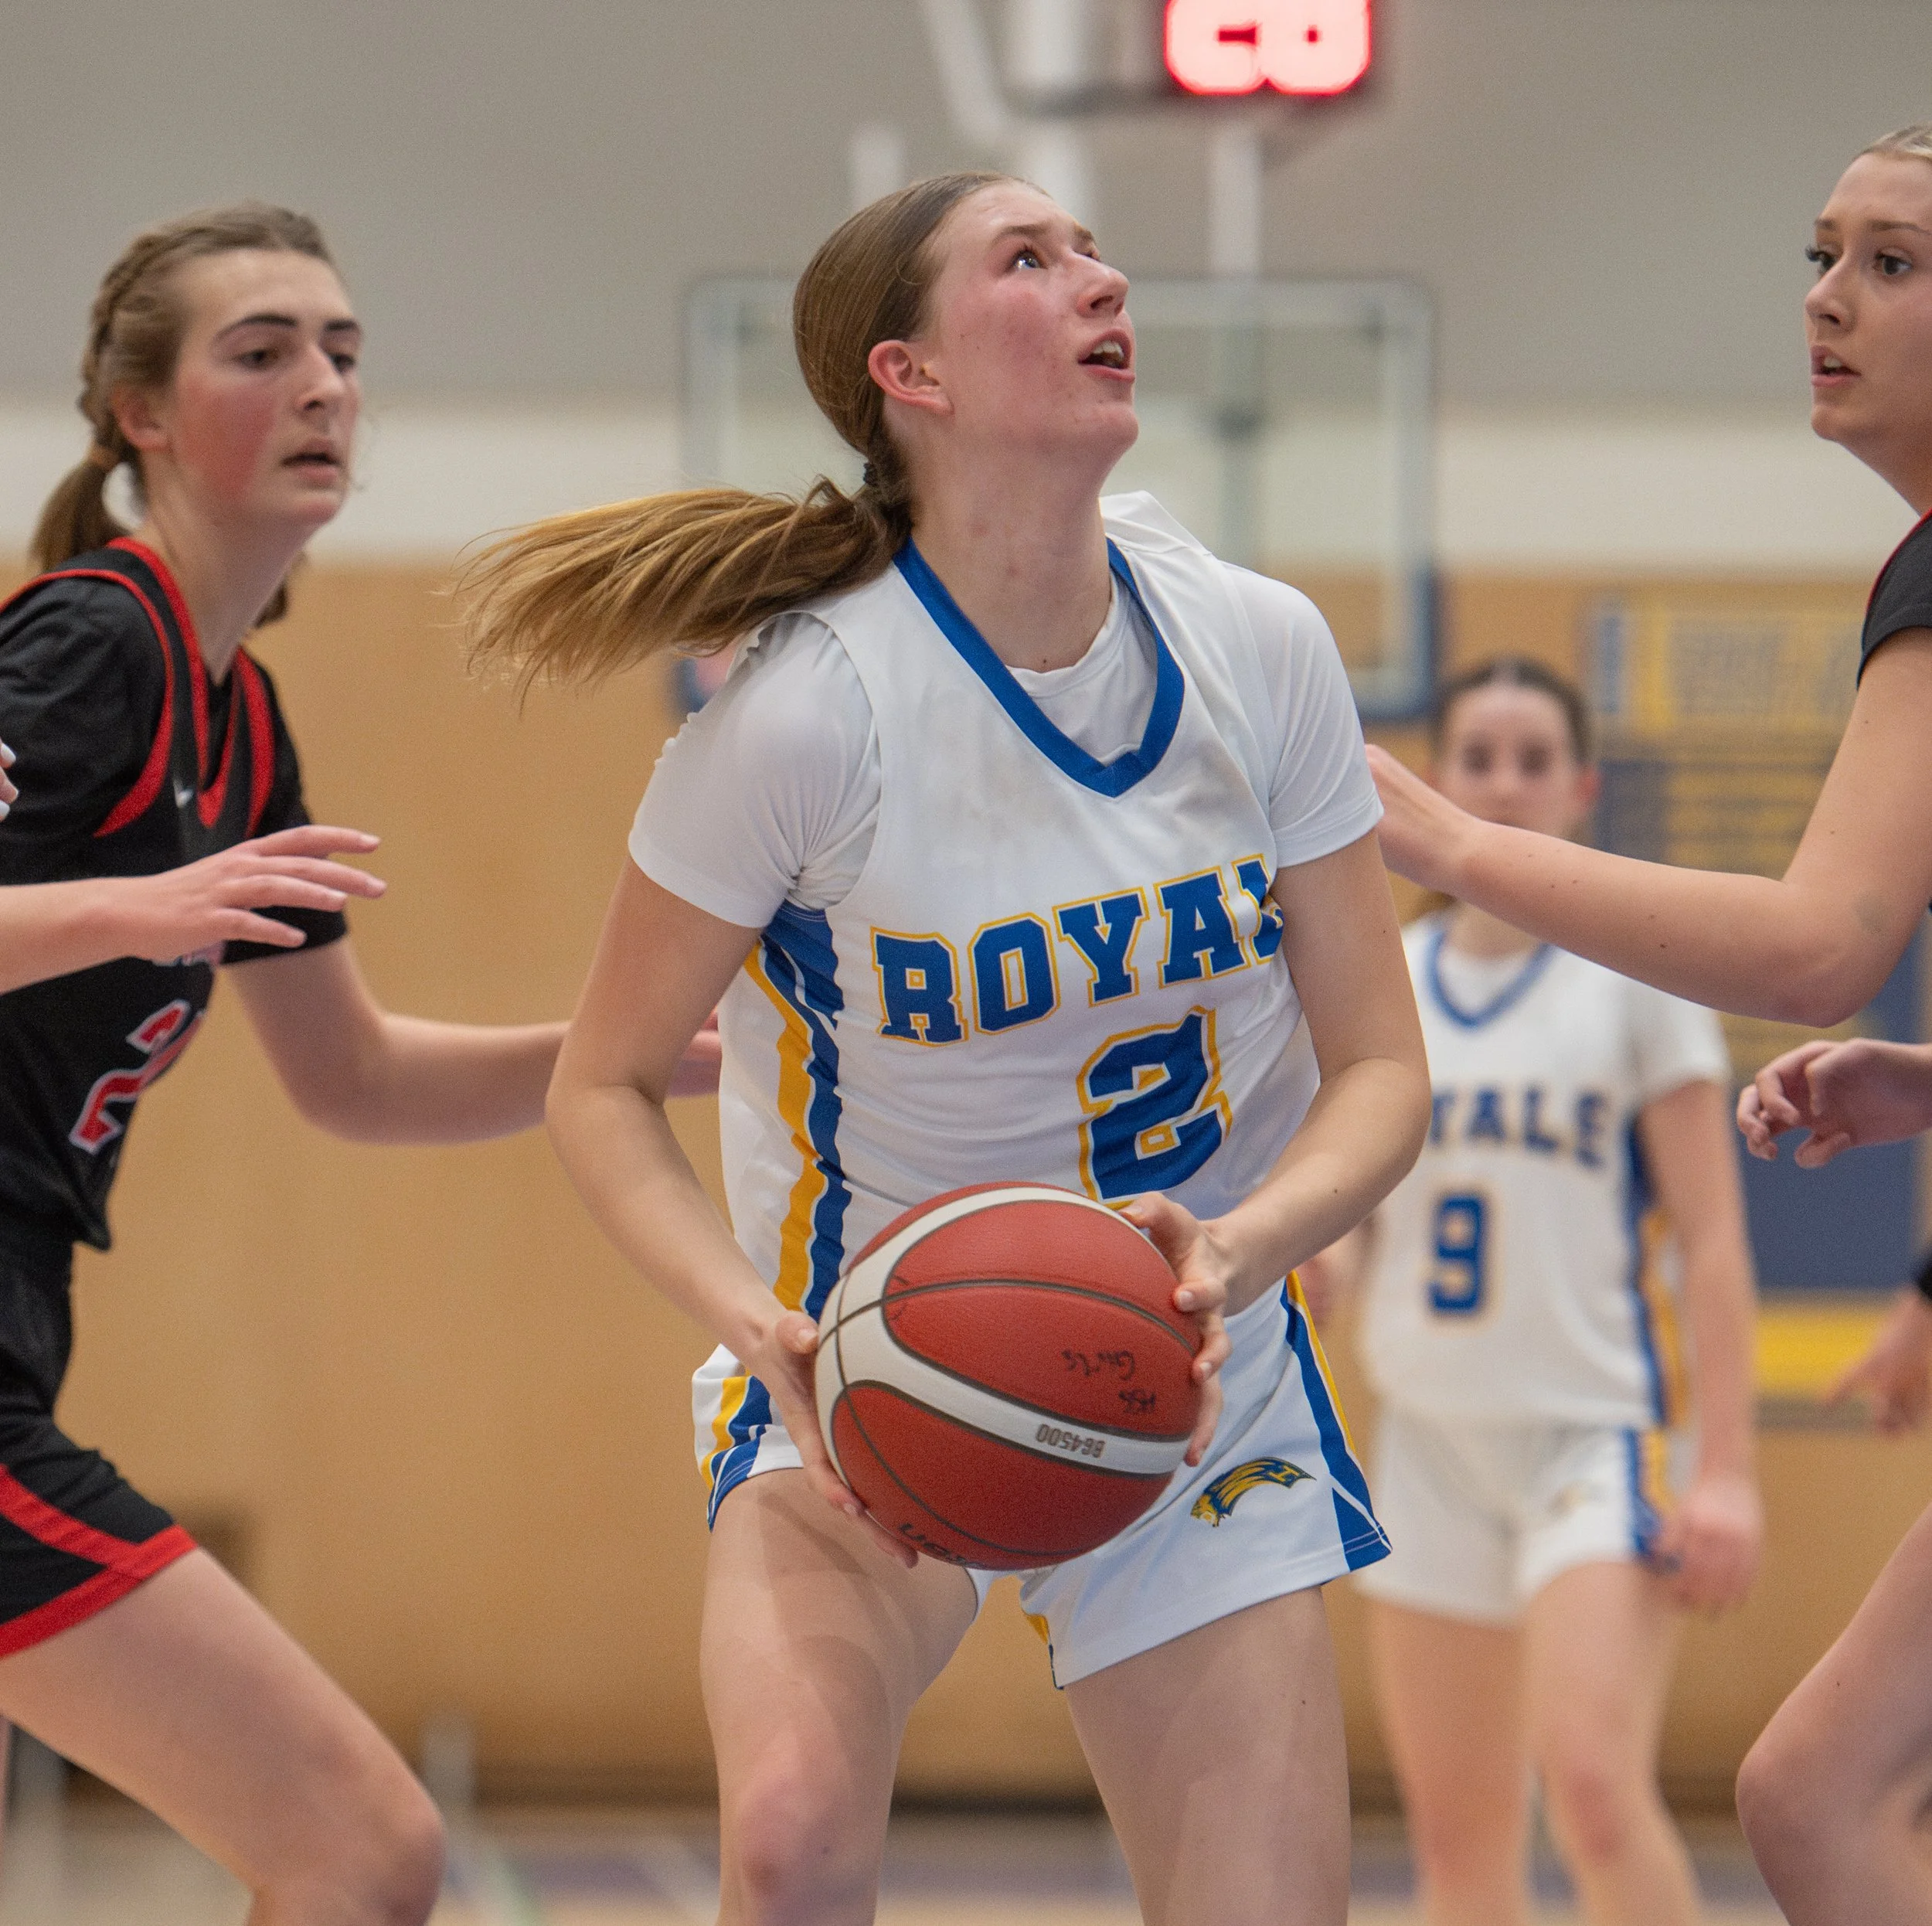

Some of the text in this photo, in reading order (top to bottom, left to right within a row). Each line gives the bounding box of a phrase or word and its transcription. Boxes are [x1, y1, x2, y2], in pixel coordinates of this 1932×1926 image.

[70, 1000, 202, 1155] 2
[1077, 1006, 1232, 1210] 2
[1426, 1186, 1488, 1315] 9
